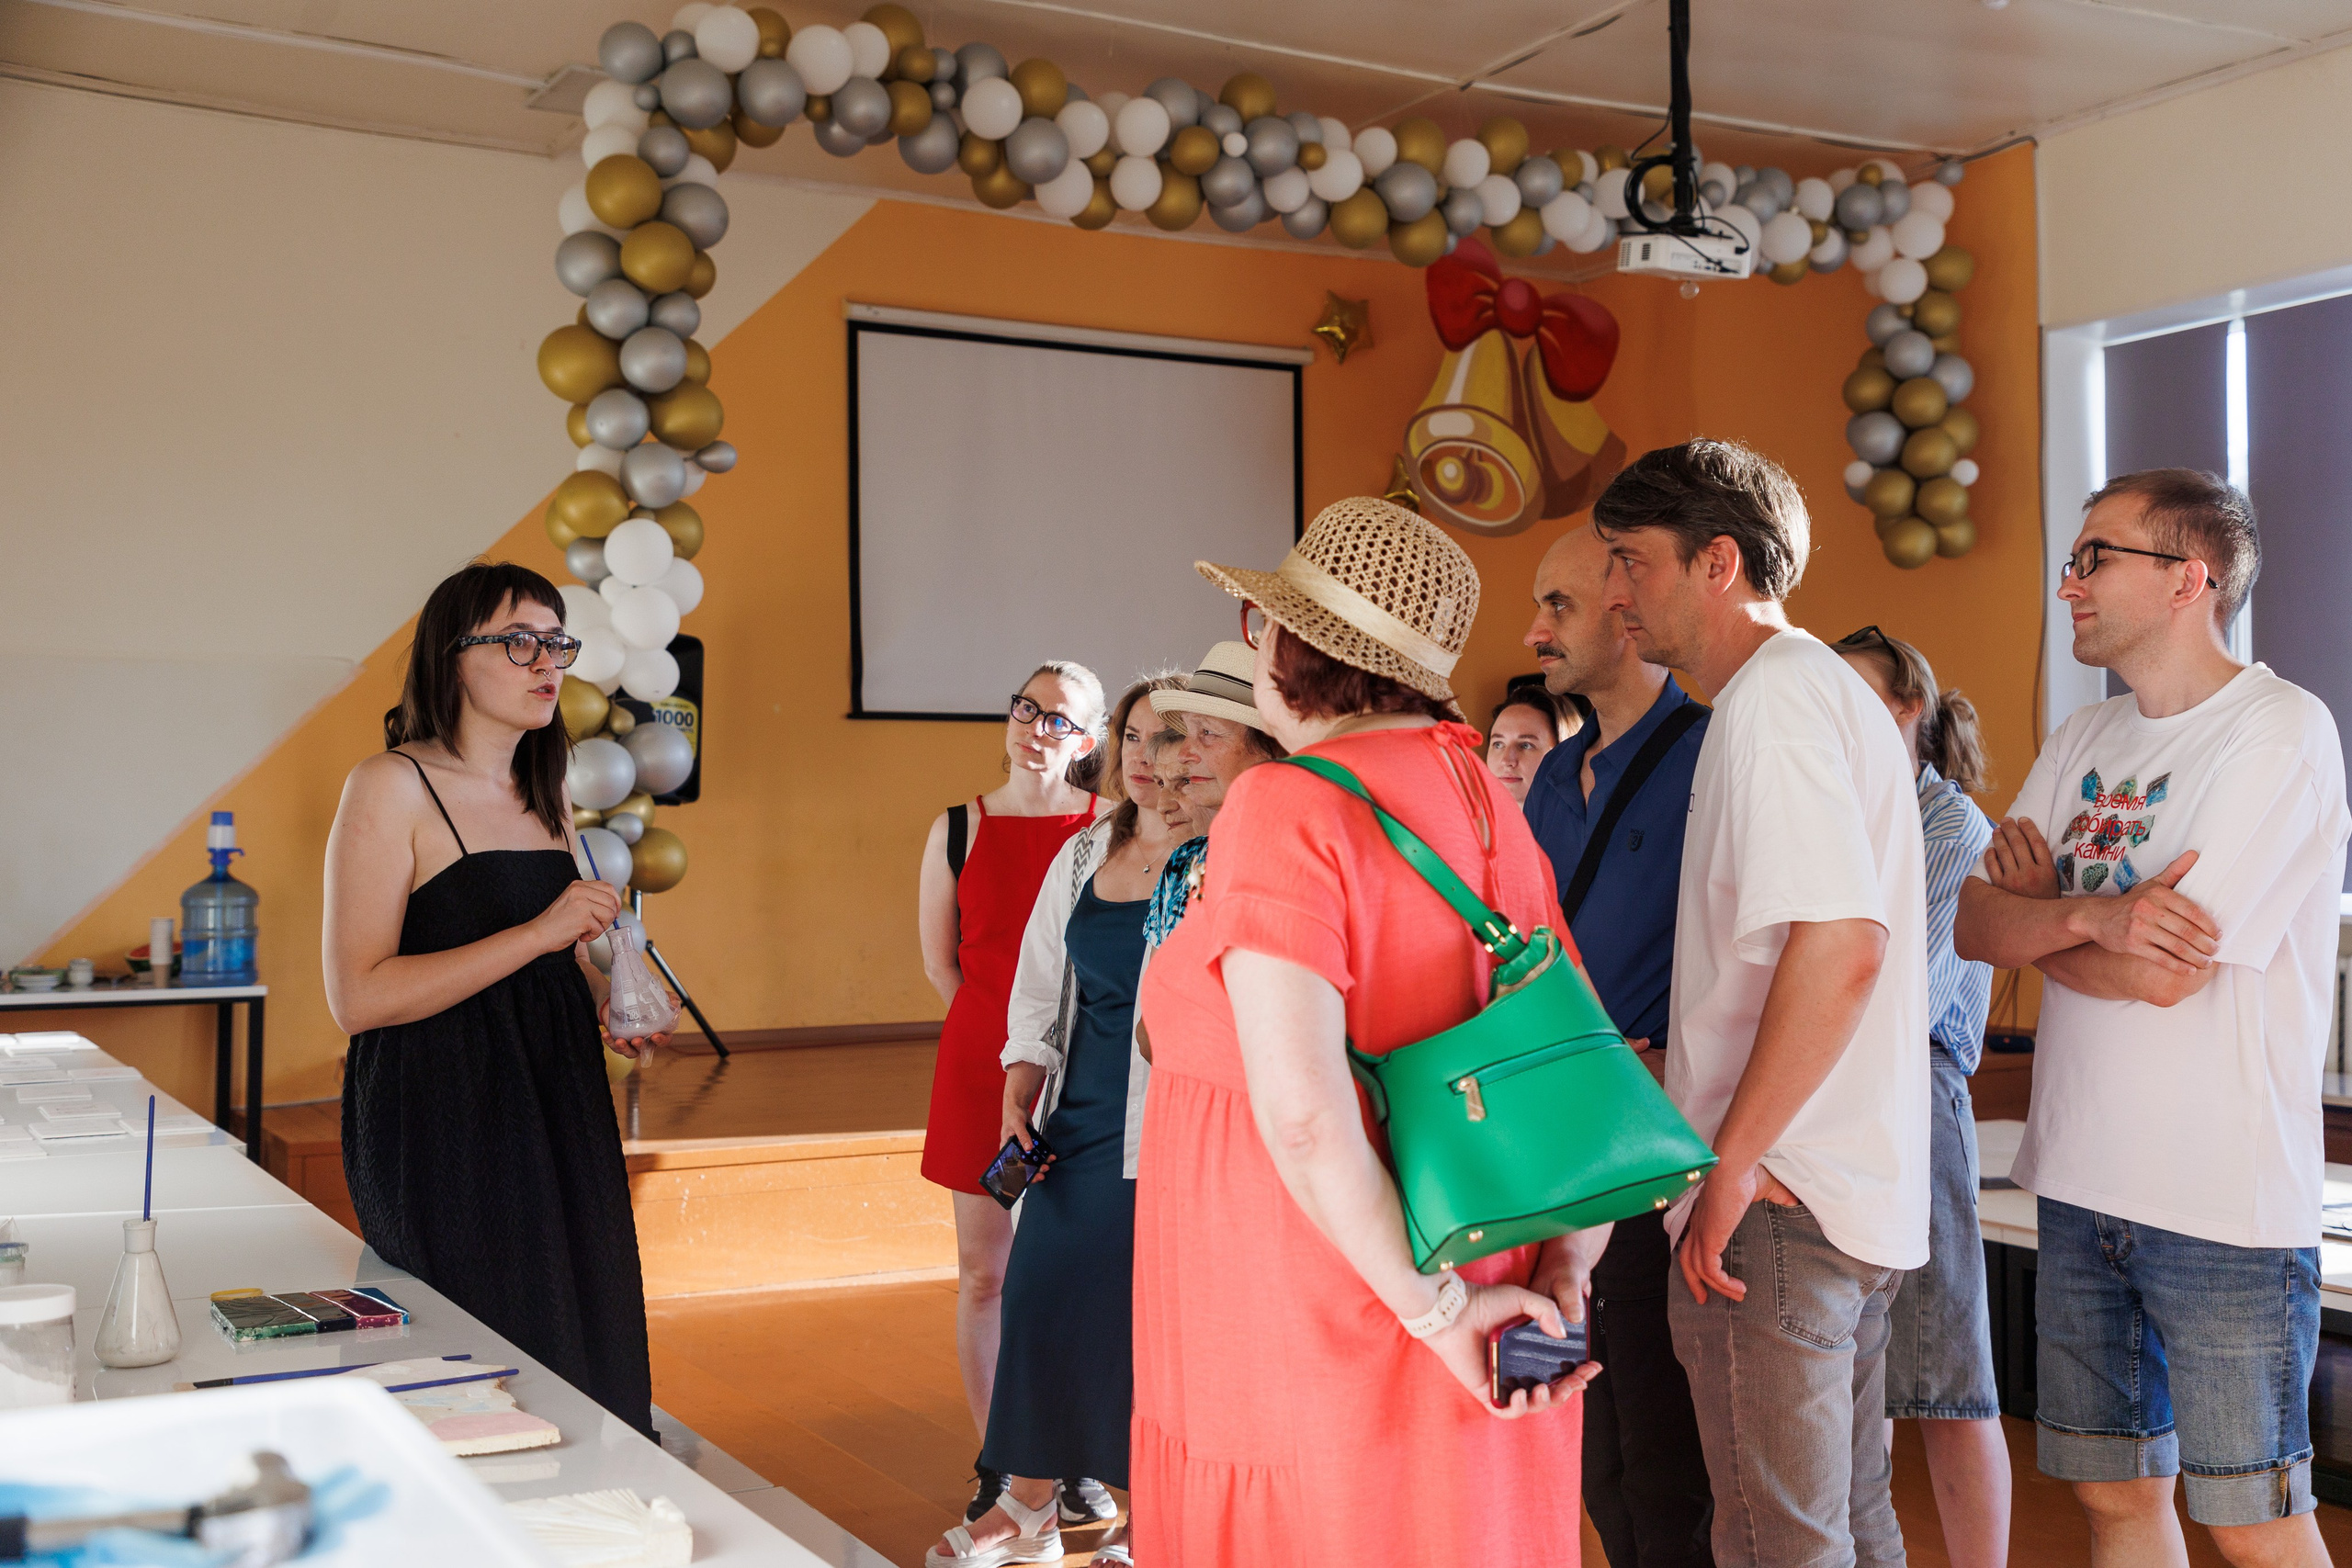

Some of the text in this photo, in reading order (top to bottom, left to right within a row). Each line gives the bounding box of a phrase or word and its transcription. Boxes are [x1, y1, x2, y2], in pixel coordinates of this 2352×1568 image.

[655, 709, 695, 728] 1000
[2093, 792, 2147, 812] время
[2072, 812, 2146, 840] собирать
[2074, 841, 2126, 862] камни
